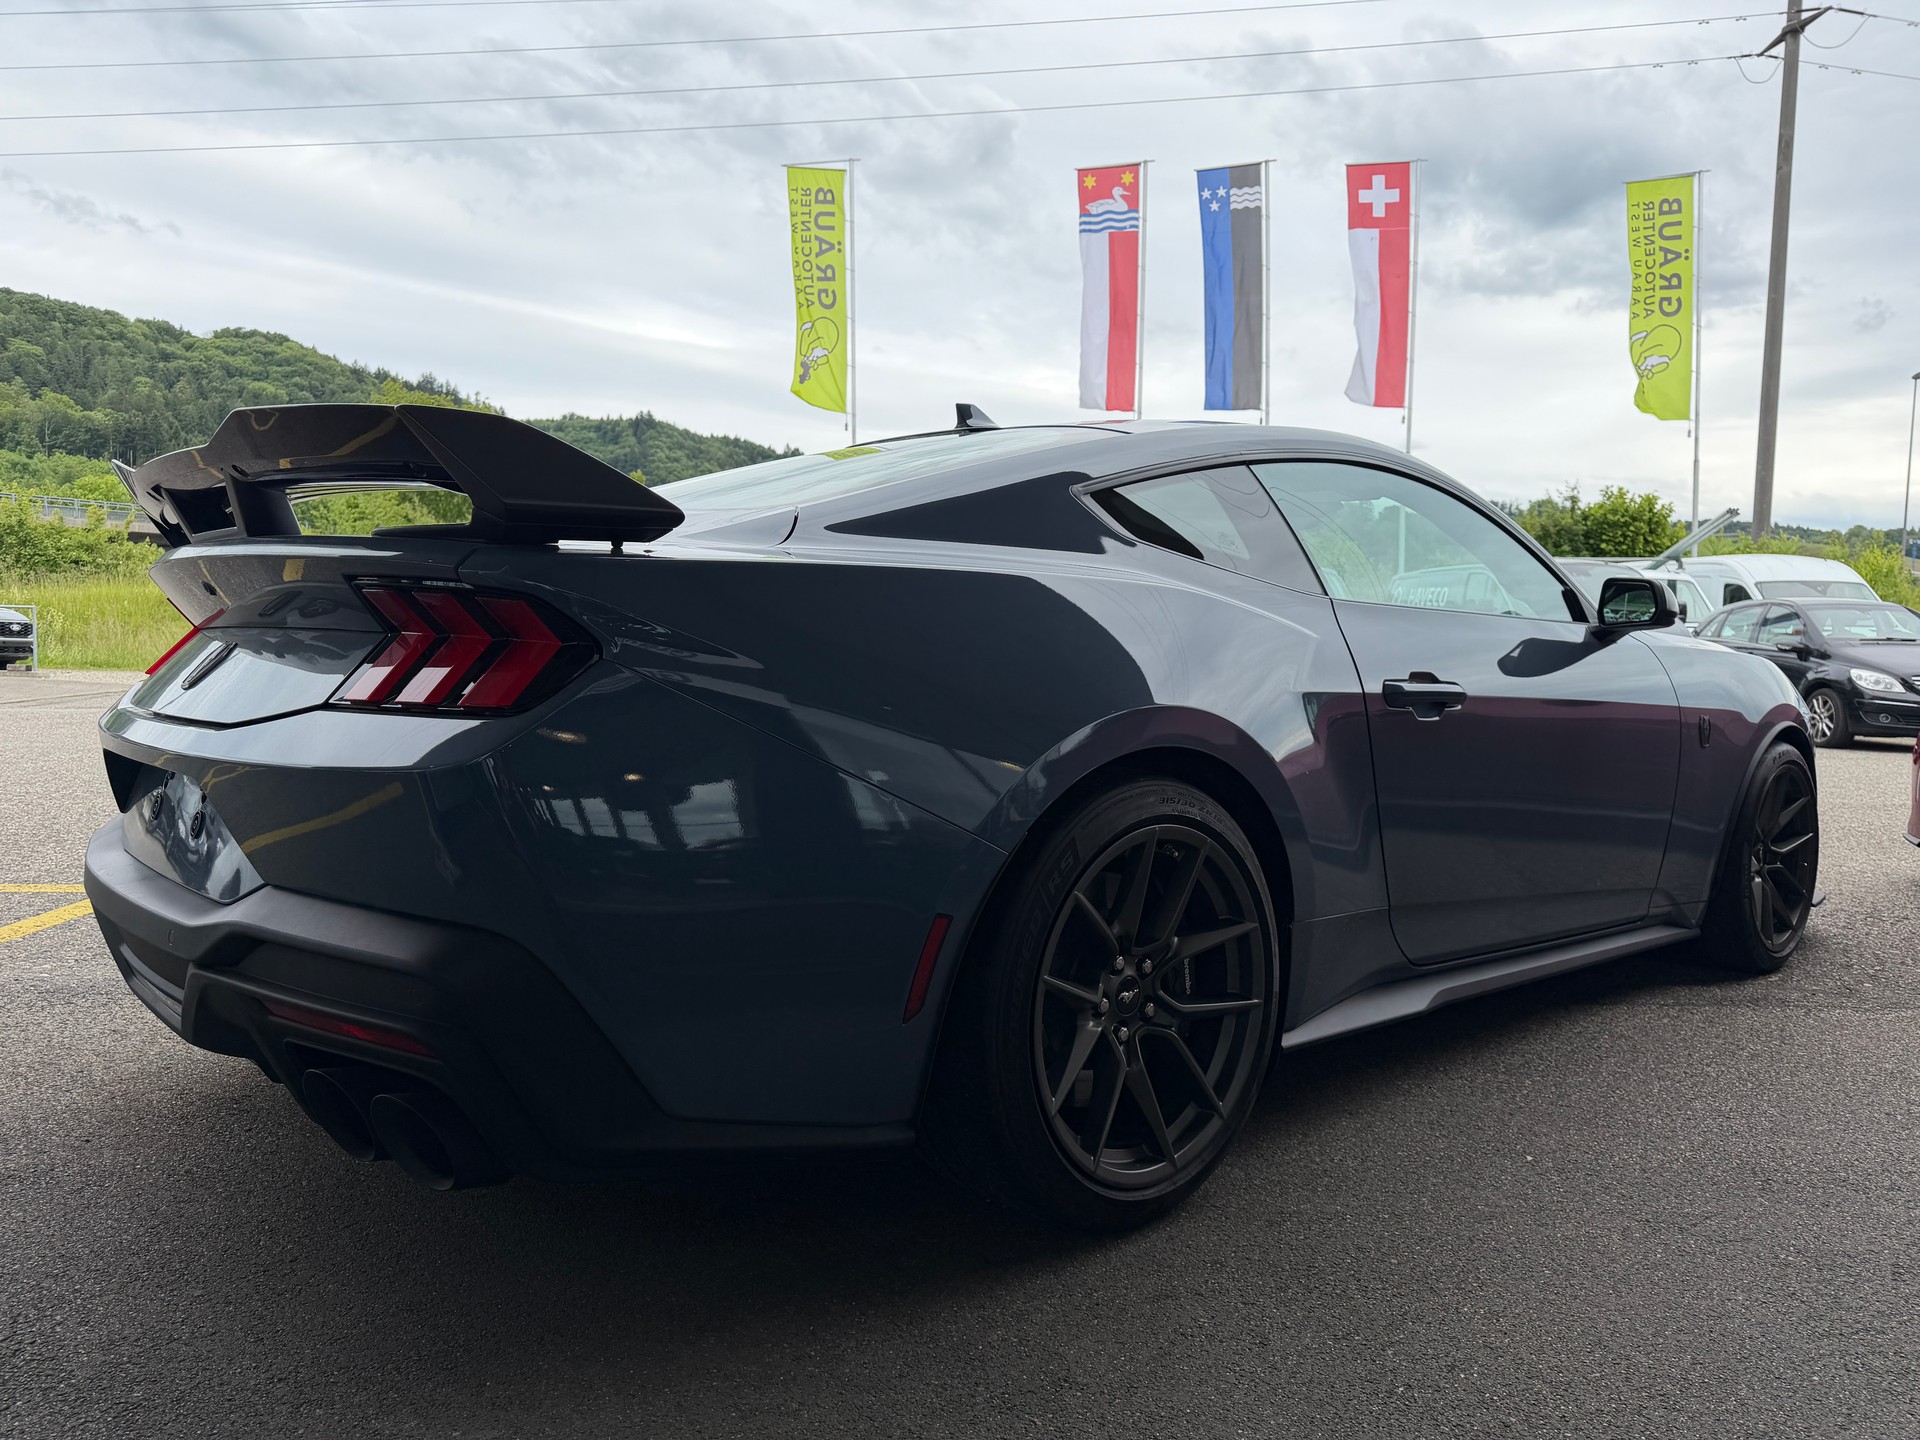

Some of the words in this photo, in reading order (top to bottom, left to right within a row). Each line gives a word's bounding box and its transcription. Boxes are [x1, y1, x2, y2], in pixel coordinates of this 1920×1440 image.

[1408, 588, 1449, 607] HAVECO
[1158, 796, 1196, 809] 315/30
[1047, 849, 1074, 893] RS
[1183, 957, 1192, 995] brembo
